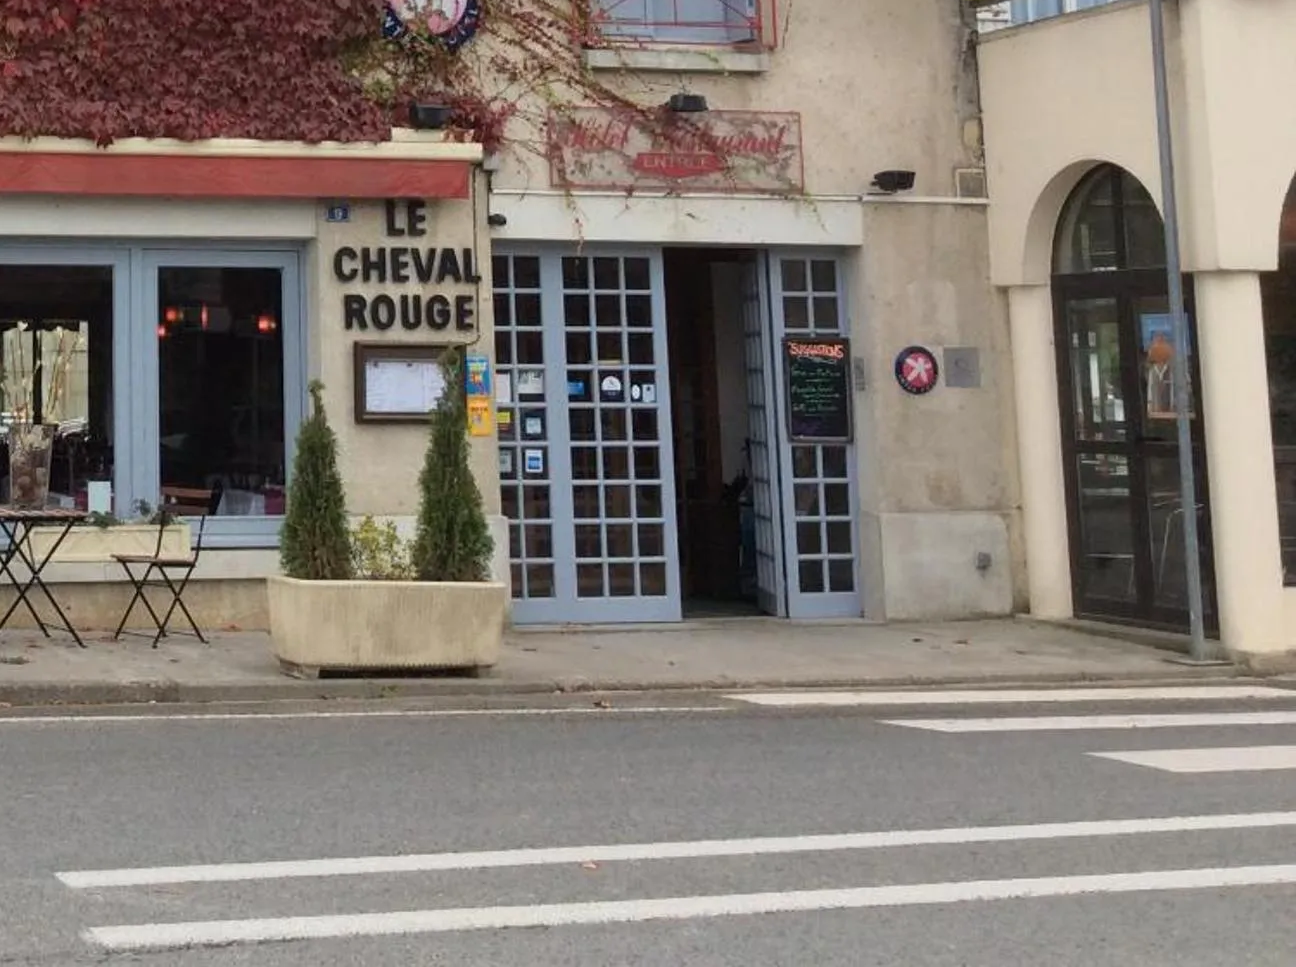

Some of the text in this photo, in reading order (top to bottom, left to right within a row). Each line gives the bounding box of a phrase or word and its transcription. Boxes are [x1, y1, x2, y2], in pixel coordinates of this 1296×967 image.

[386, 199, 426, 236] LE
[333, 246, 481, 283] CHEVAL
[344, 294, 474, 330] ROUGE
